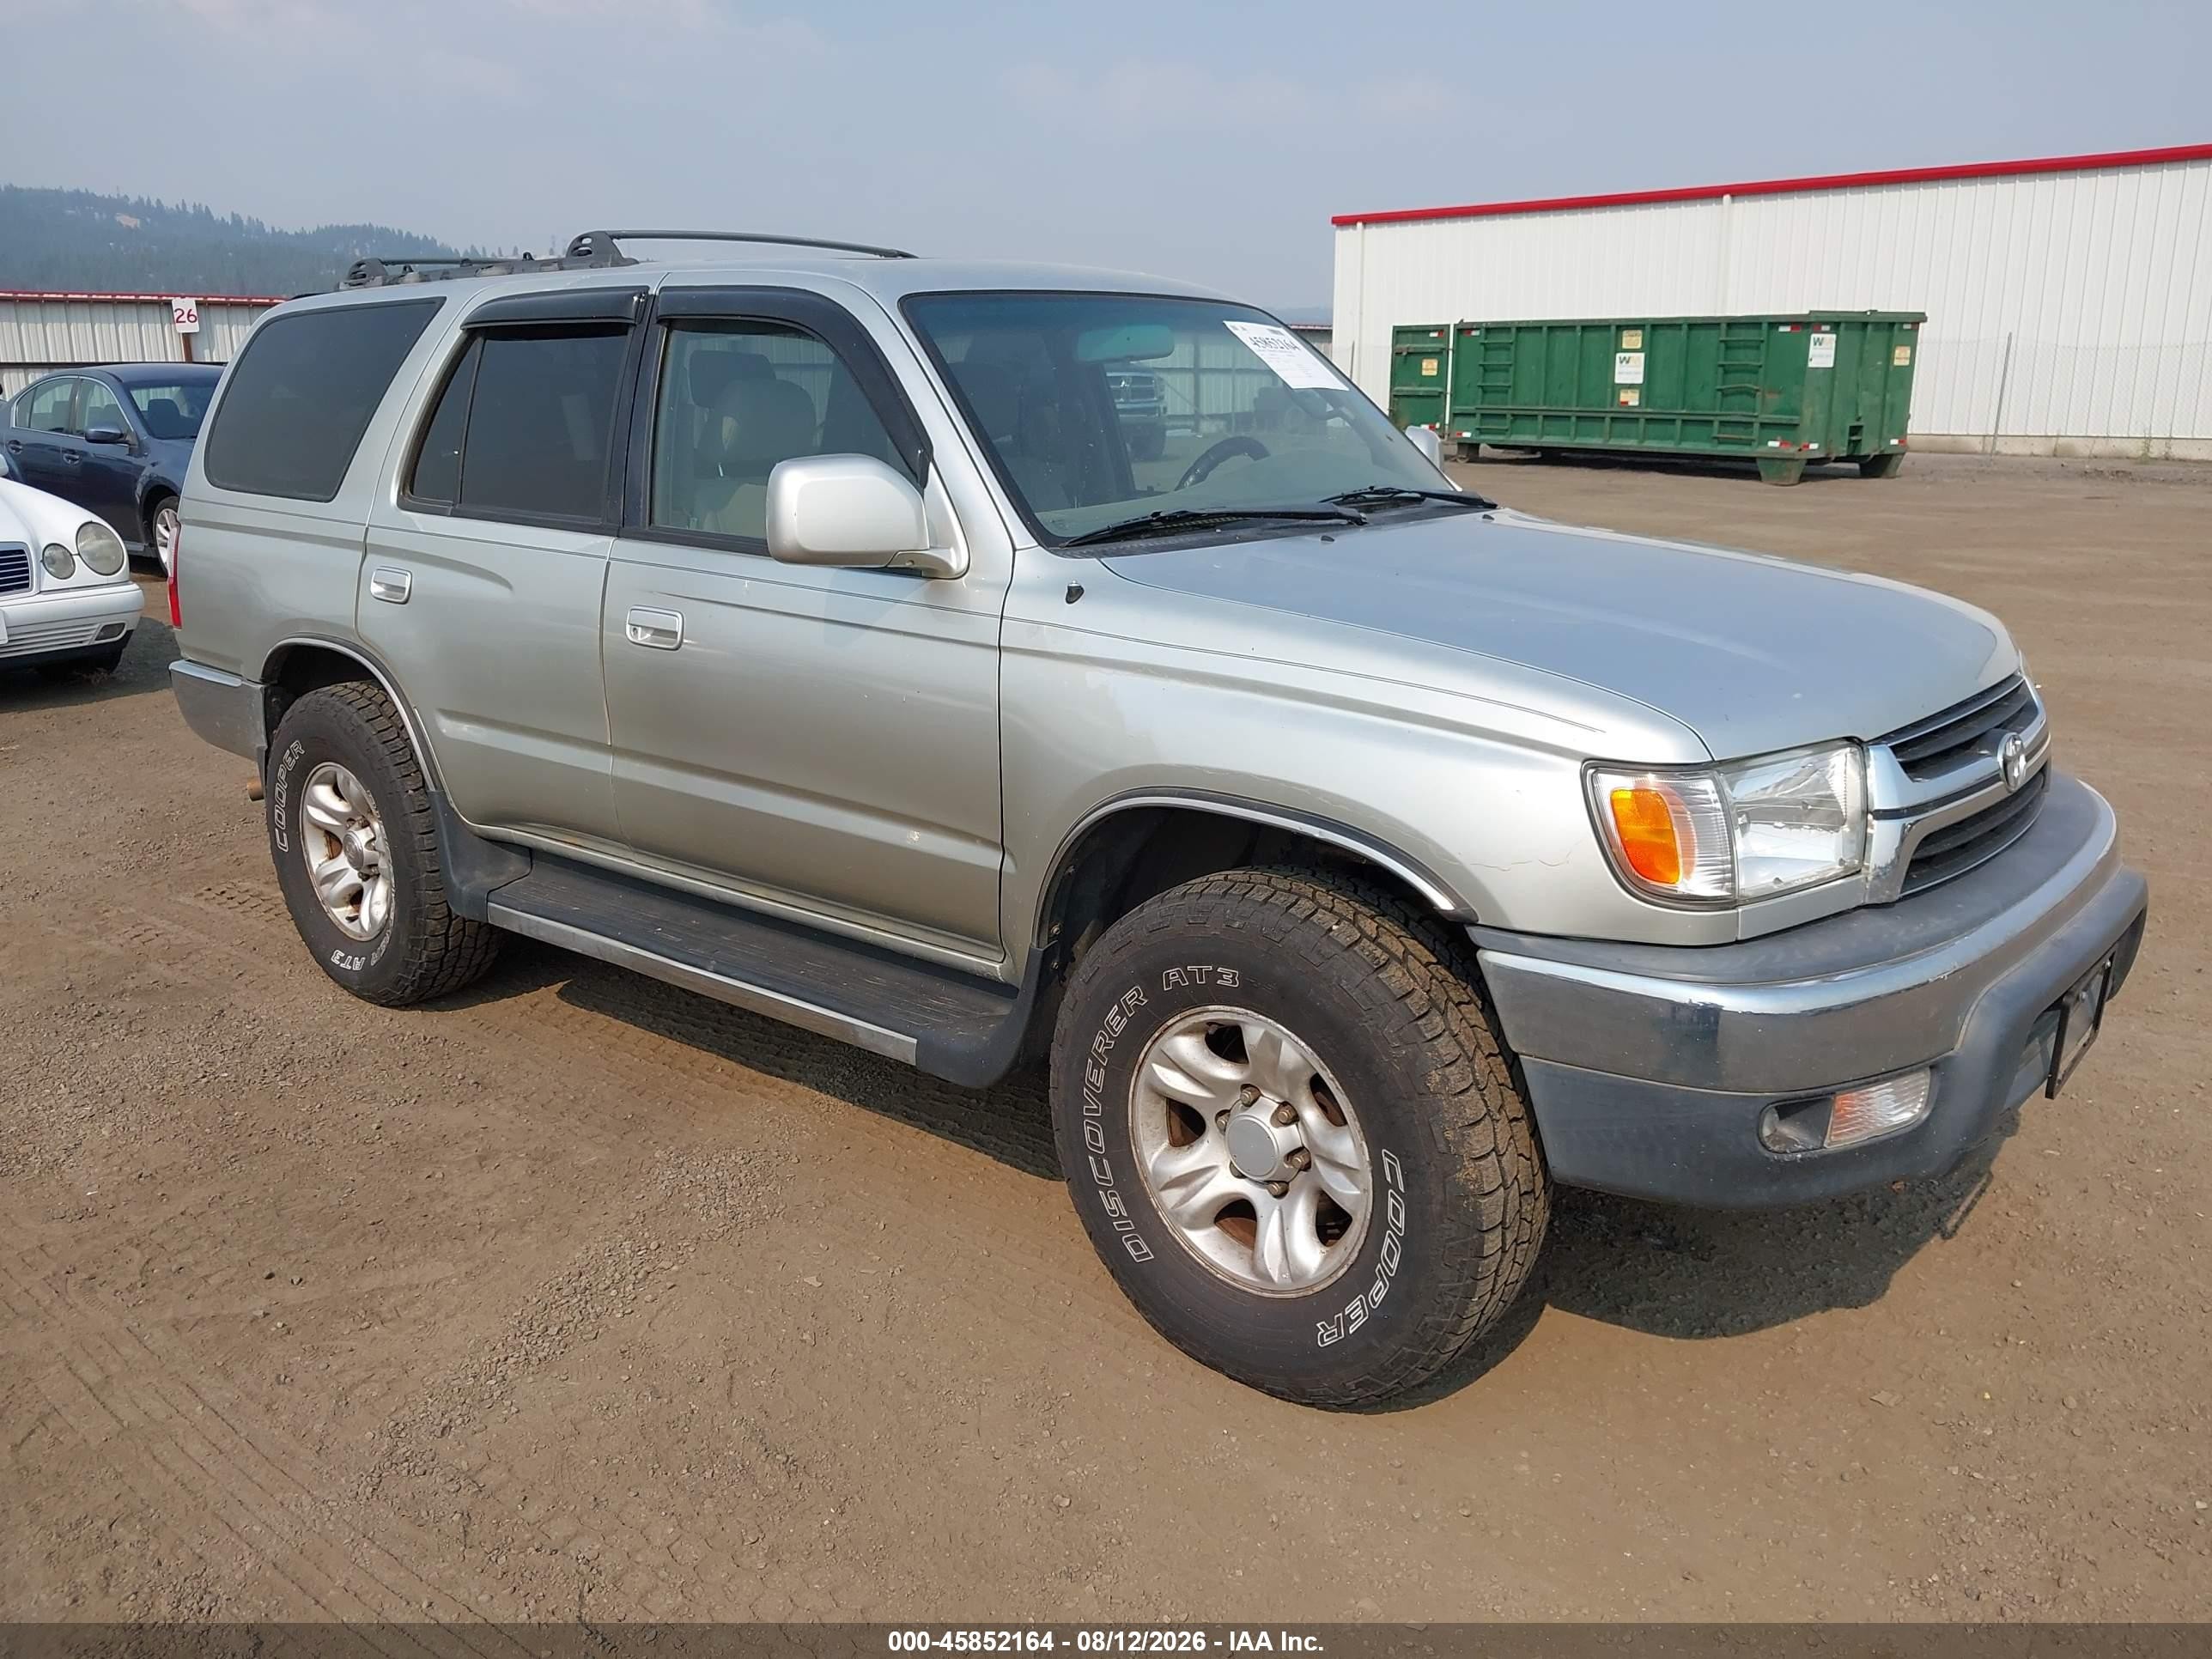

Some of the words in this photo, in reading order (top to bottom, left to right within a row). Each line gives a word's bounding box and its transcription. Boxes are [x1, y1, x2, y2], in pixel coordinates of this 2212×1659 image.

[174, 307, 198, 324] 26
[274, 739, 306, 853] COOPER
[331, 949, 367, 971] AT3
[1083, 986, 1155, 1263] DISCOVERER
[1162, 965, 1240, 991] AT3
[1316, 1148, 1406, 1348] COOPER
